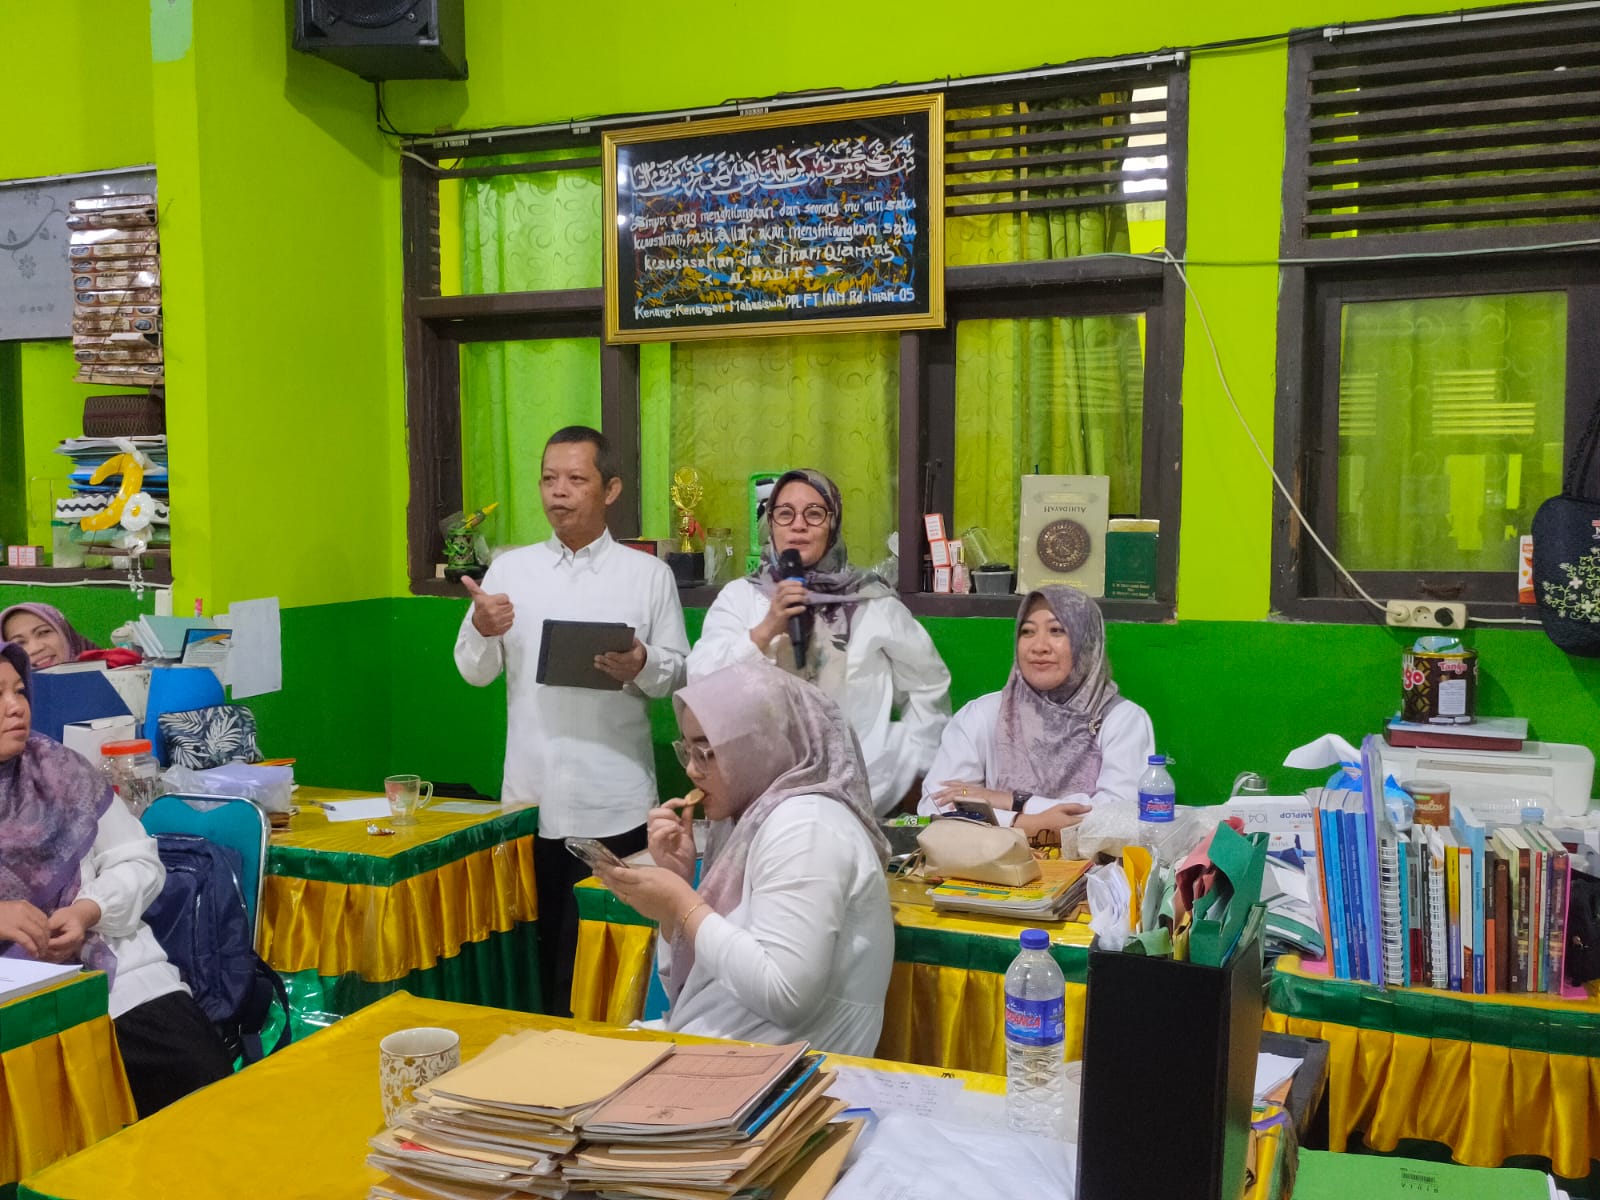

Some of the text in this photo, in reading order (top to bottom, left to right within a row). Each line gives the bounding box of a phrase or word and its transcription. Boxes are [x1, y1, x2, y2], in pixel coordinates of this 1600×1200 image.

[671, 211, 697, 230] yang
[780, 201, 800, 217] dari
[884, 192, 916, 211] satu
[882, 217, 917, 236] satu
[803, 292, 820, 307] FT
[1437, 661, 1468, 675] Tango
